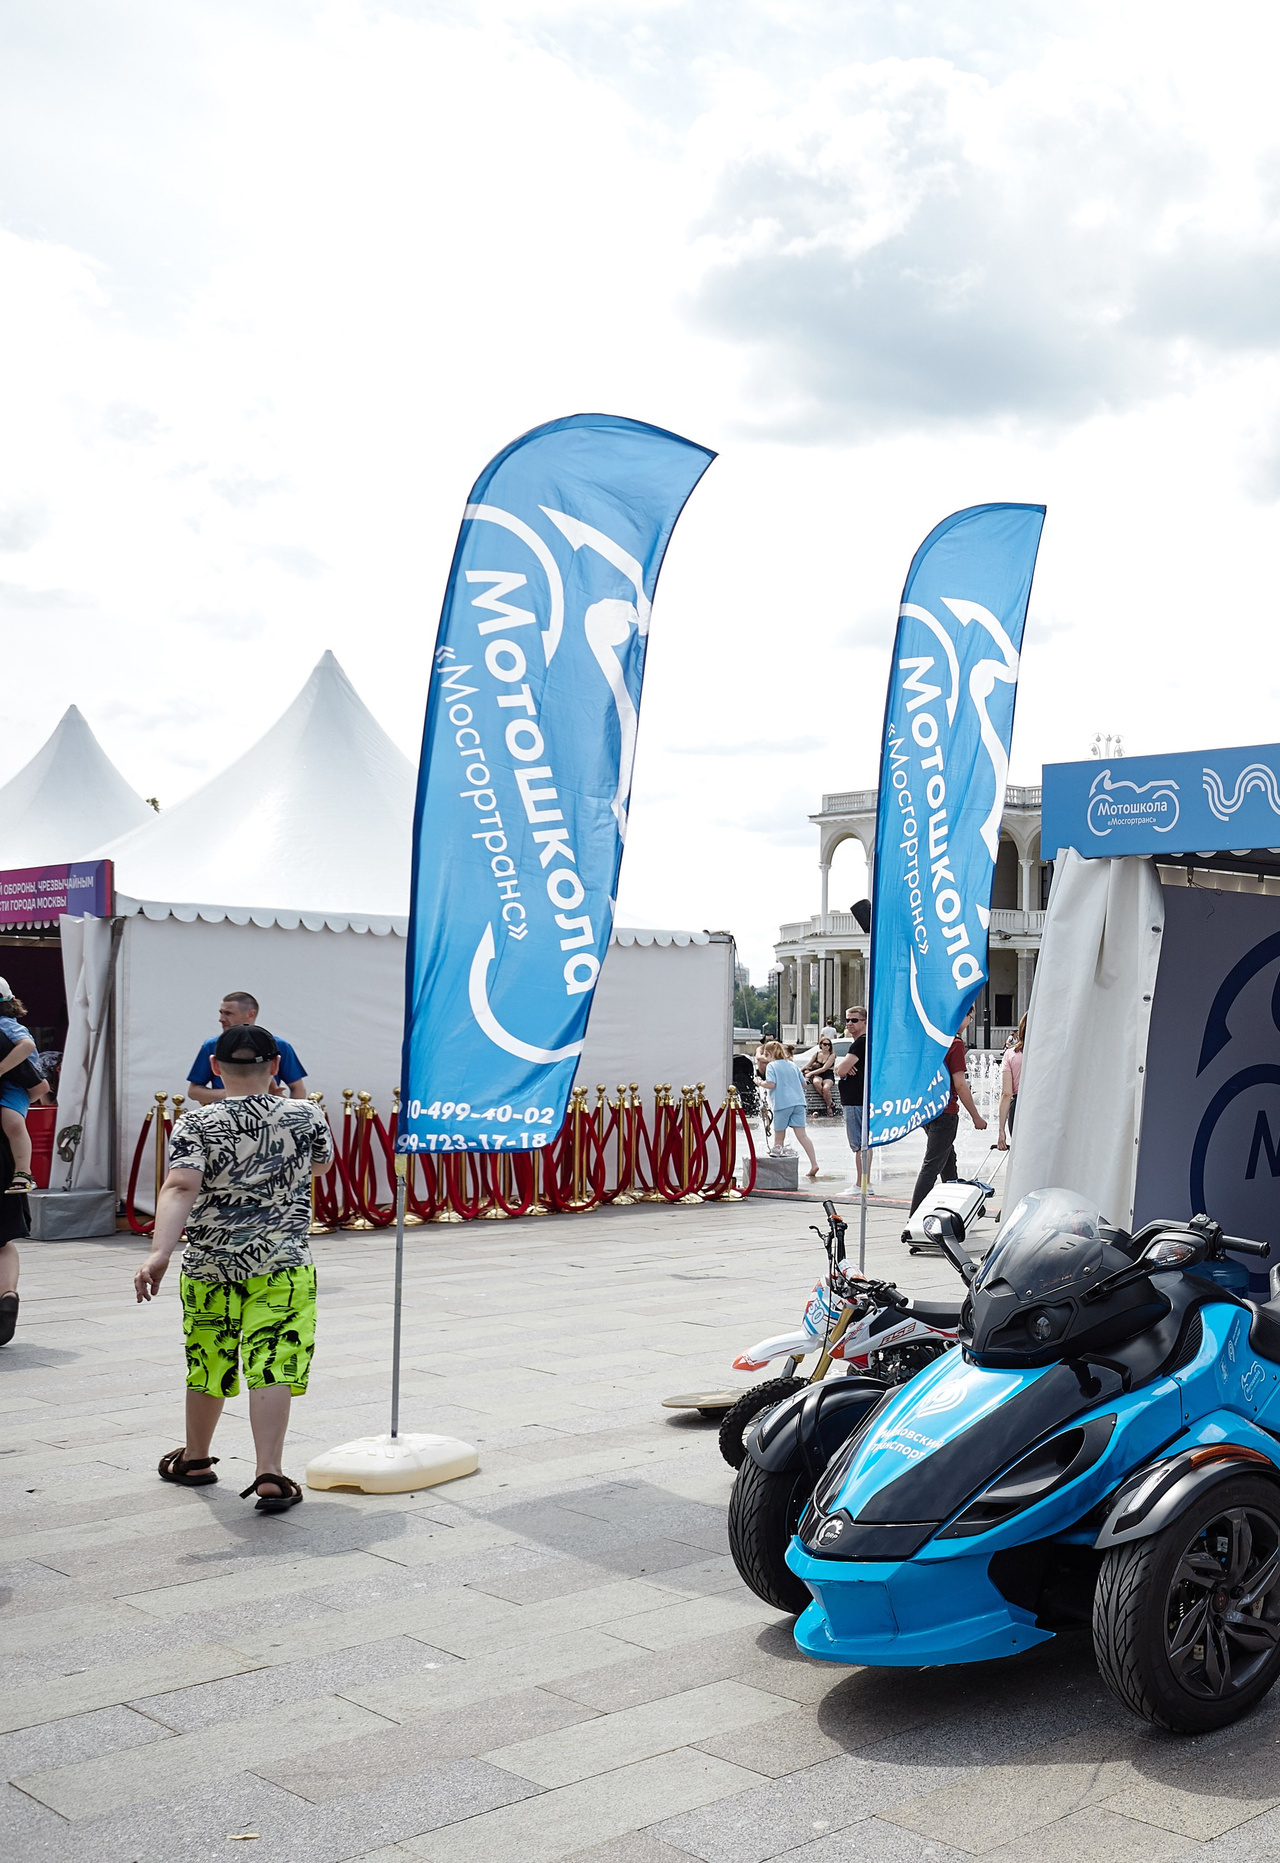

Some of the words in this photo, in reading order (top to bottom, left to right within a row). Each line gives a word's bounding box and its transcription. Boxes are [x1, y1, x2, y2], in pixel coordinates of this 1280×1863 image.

[435, 645, 529, 941] «Мосгортранс»
[464, 570, 600, 996] Мотошкола
[888, 722, 930, 956] «Мосгортранс»
[899, 656, 984, 991] Мотошкола
[1097, 801, 1168, 816] Мотошкола
[1107, 816, 1157, 826] «Мосгортранс»
[10, 898, 37, 911] ГОРОДА
[37, 896, 67, 908] МОСКВЫ
[38, 874, 94, 891] ЧРЕЗВЫЧАЙНЫМ
